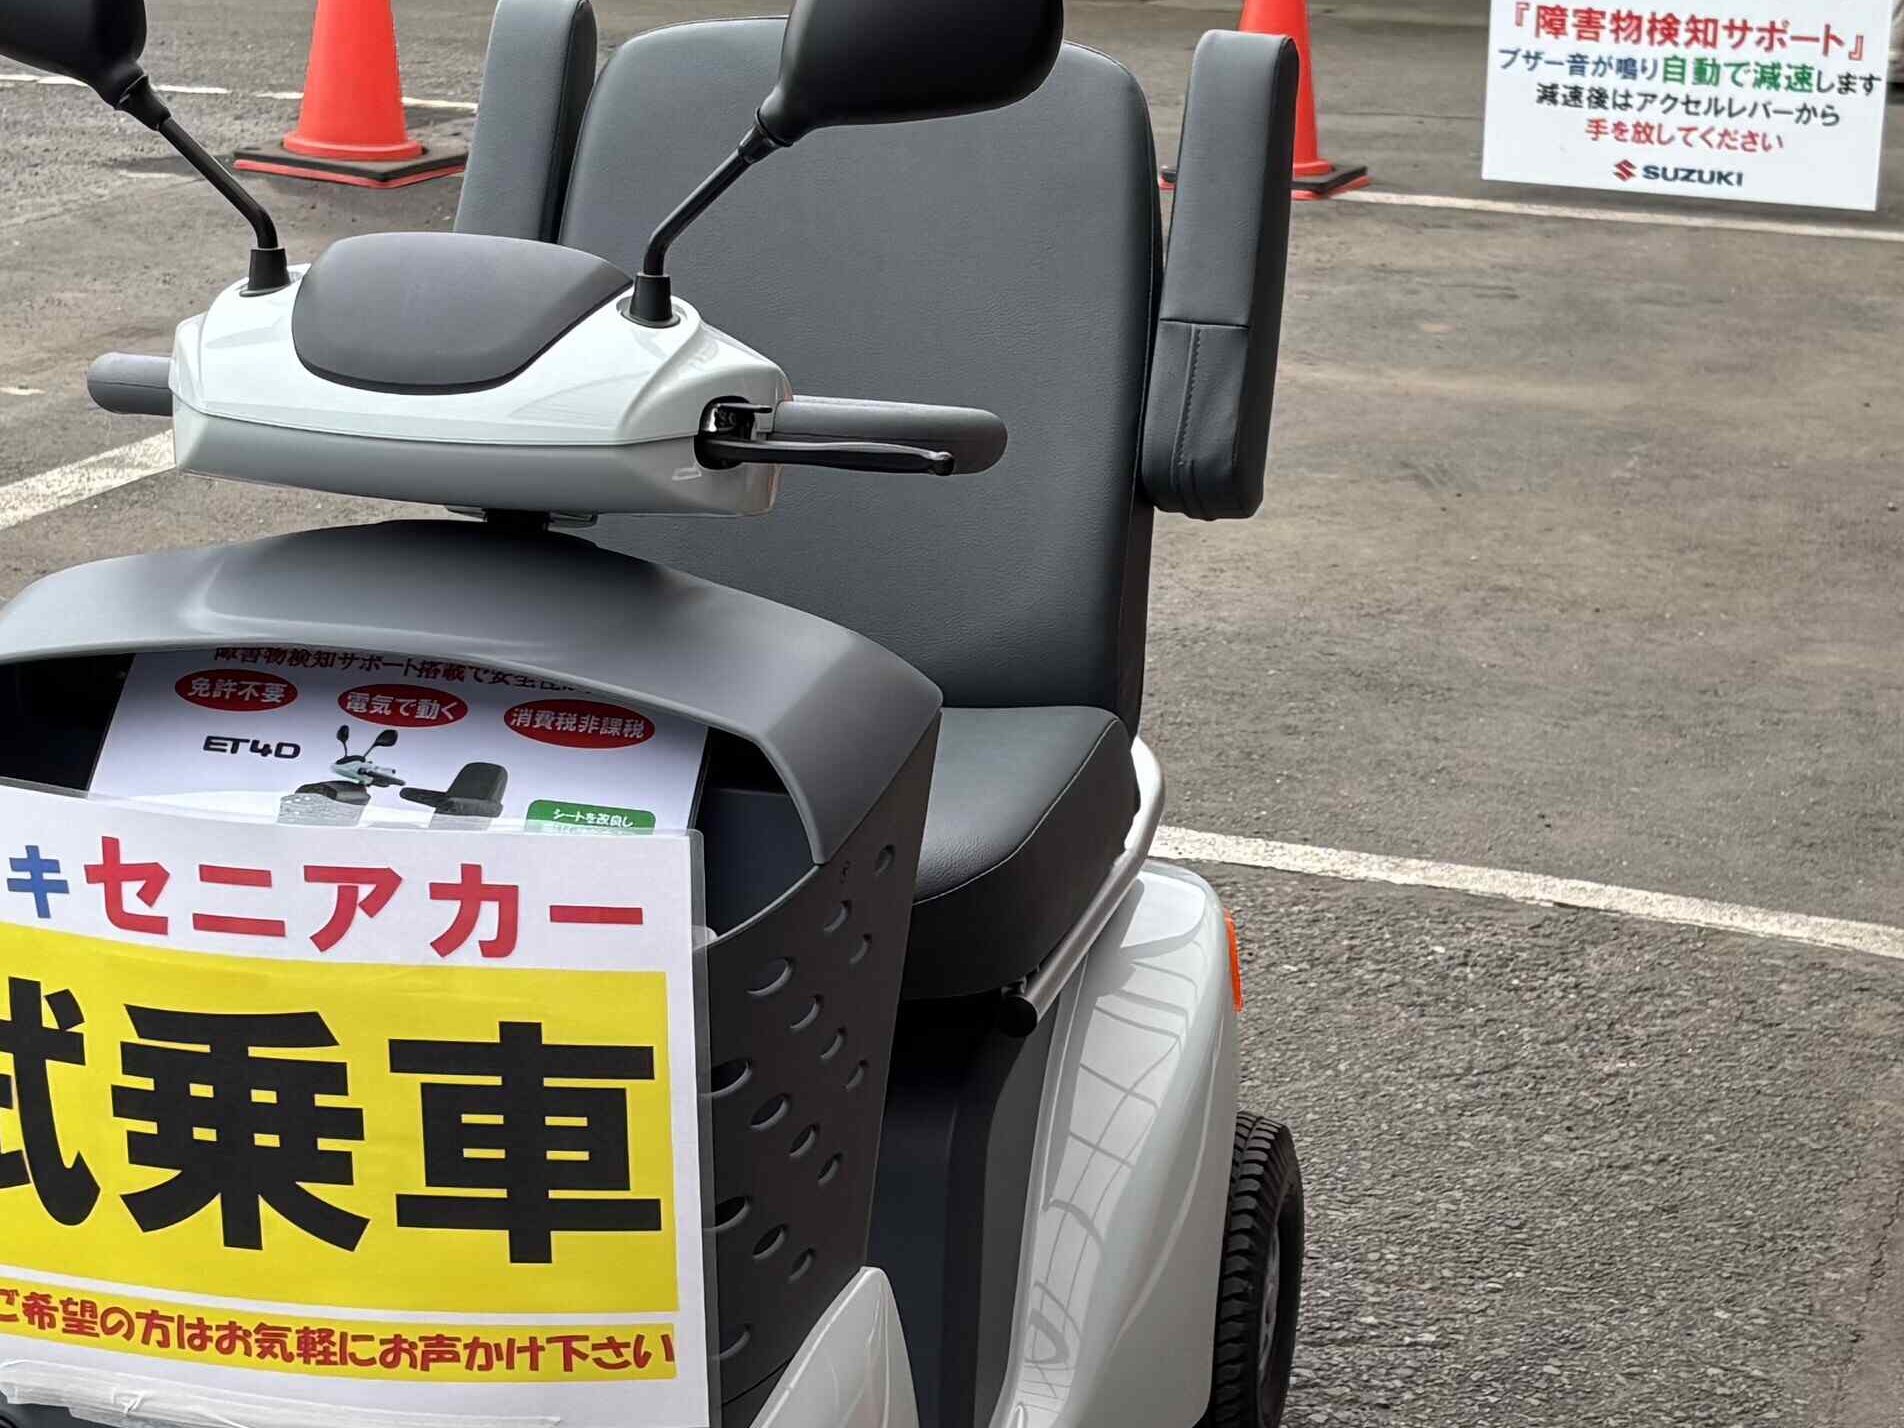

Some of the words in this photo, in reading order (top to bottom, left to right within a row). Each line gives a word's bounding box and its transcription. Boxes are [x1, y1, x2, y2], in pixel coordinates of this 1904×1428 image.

[1514, 1, 1864, 61] 『障害物検知サポート』
[1498, 48, 1883, 96] ブザー音が鳴り自動で減速します
[1536, 83, 1841, 126] 減速後はアクセルレバーから
[1585, 118, 1784, 152] 手を放してください
[1642, 164, 1744, 187] SUZUKI
[187, 677, 288, 704] 免許不要
[345, 691, 458, 721] 電気で動く
[510, 707, 646, 739] 消費税非課税
[202, 735, 302, 760] ET4D
